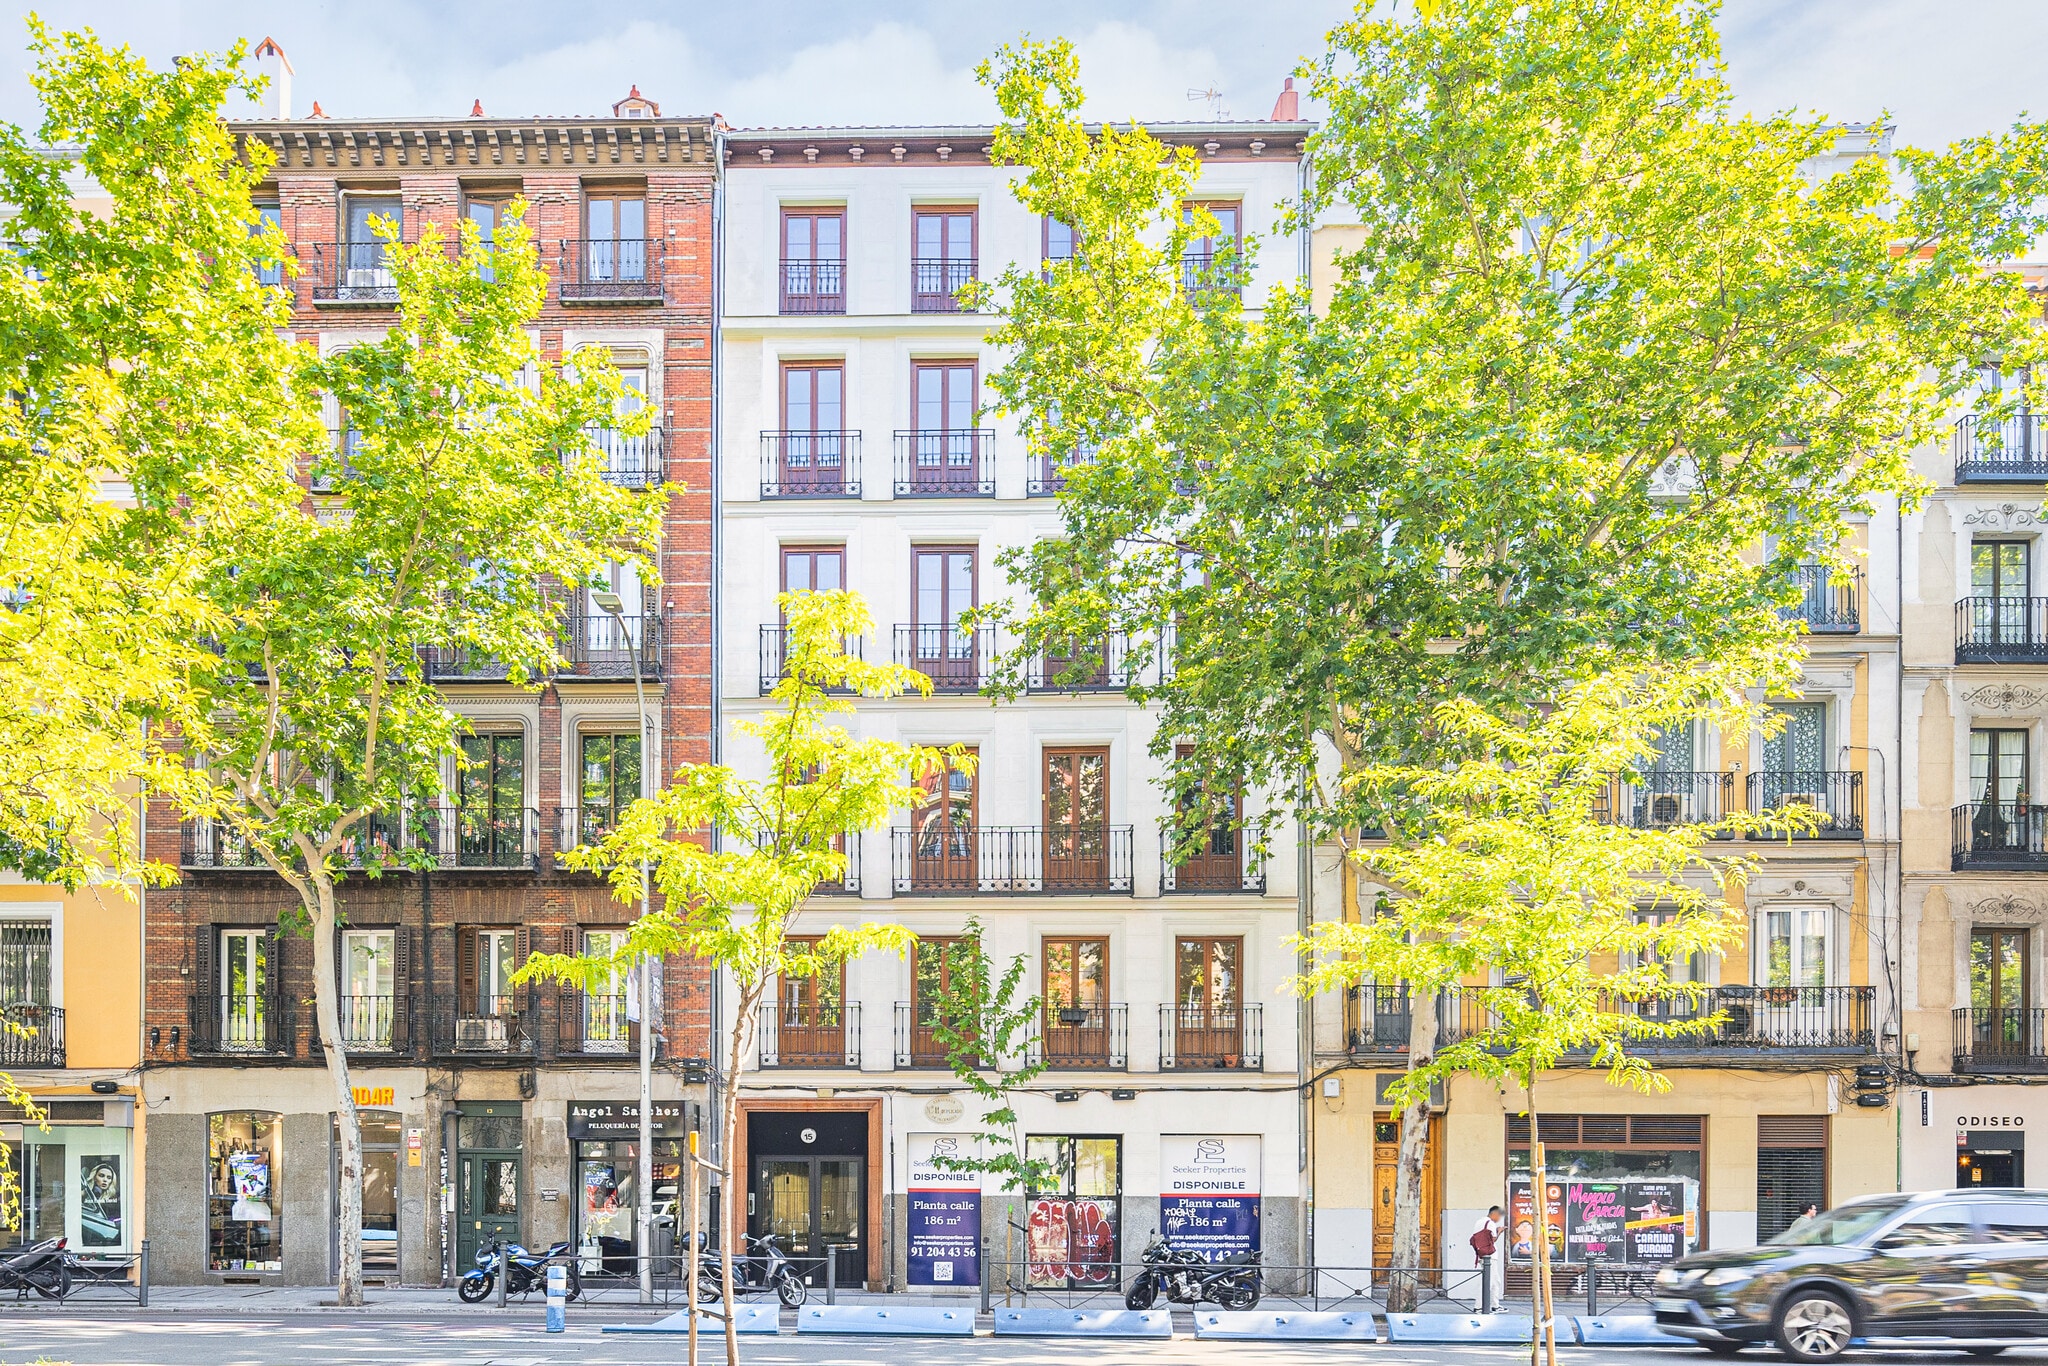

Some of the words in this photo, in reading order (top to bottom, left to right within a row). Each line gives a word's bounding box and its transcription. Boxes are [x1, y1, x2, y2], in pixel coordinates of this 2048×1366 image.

[572, 1106, 613, 1119] Angel
[622, 1106, 680, 1117] Sahez
[588, 1122, 630, 1130] PELUQUERÍA
[1957, 1116, 2024, 1127] ODISEO
[1172, 1165, 1201, 1174] Seeker
[1203, 1165, 1247, 1176] Properties
[913, 1173, 975, 1181] DISPONIBLE
[1173, 1181, 1246, 1190] DISPONIBLE
[1549, 1188, 1559, 1198] Q
[1568, 1183, 1616, 1209] MANOLO
[913, 1200, 948, 1210] Planta
[950, 1201, 975, 1210] calle
[1178, 1198, 1213, 1209] Planta
[1215, 1198, 1241, 1208] calle
[924, 1216, 944, 1225] 186
[946, 1216, 961, 1225] m²
[1190, 1218, 1209, 1226] 186
[1212, 1217, 1227, 1226] m²
[1634, 1233, 1675, 1244] CARMINA
[911, 1247, 923, 1257] 91
[926, 1247, 945, 1257] 204
[948, 1247, 961, 1257] 43
[963, 1247, 976, 1257] 56
[1637, 1244, 1673, 1254] BURANA
